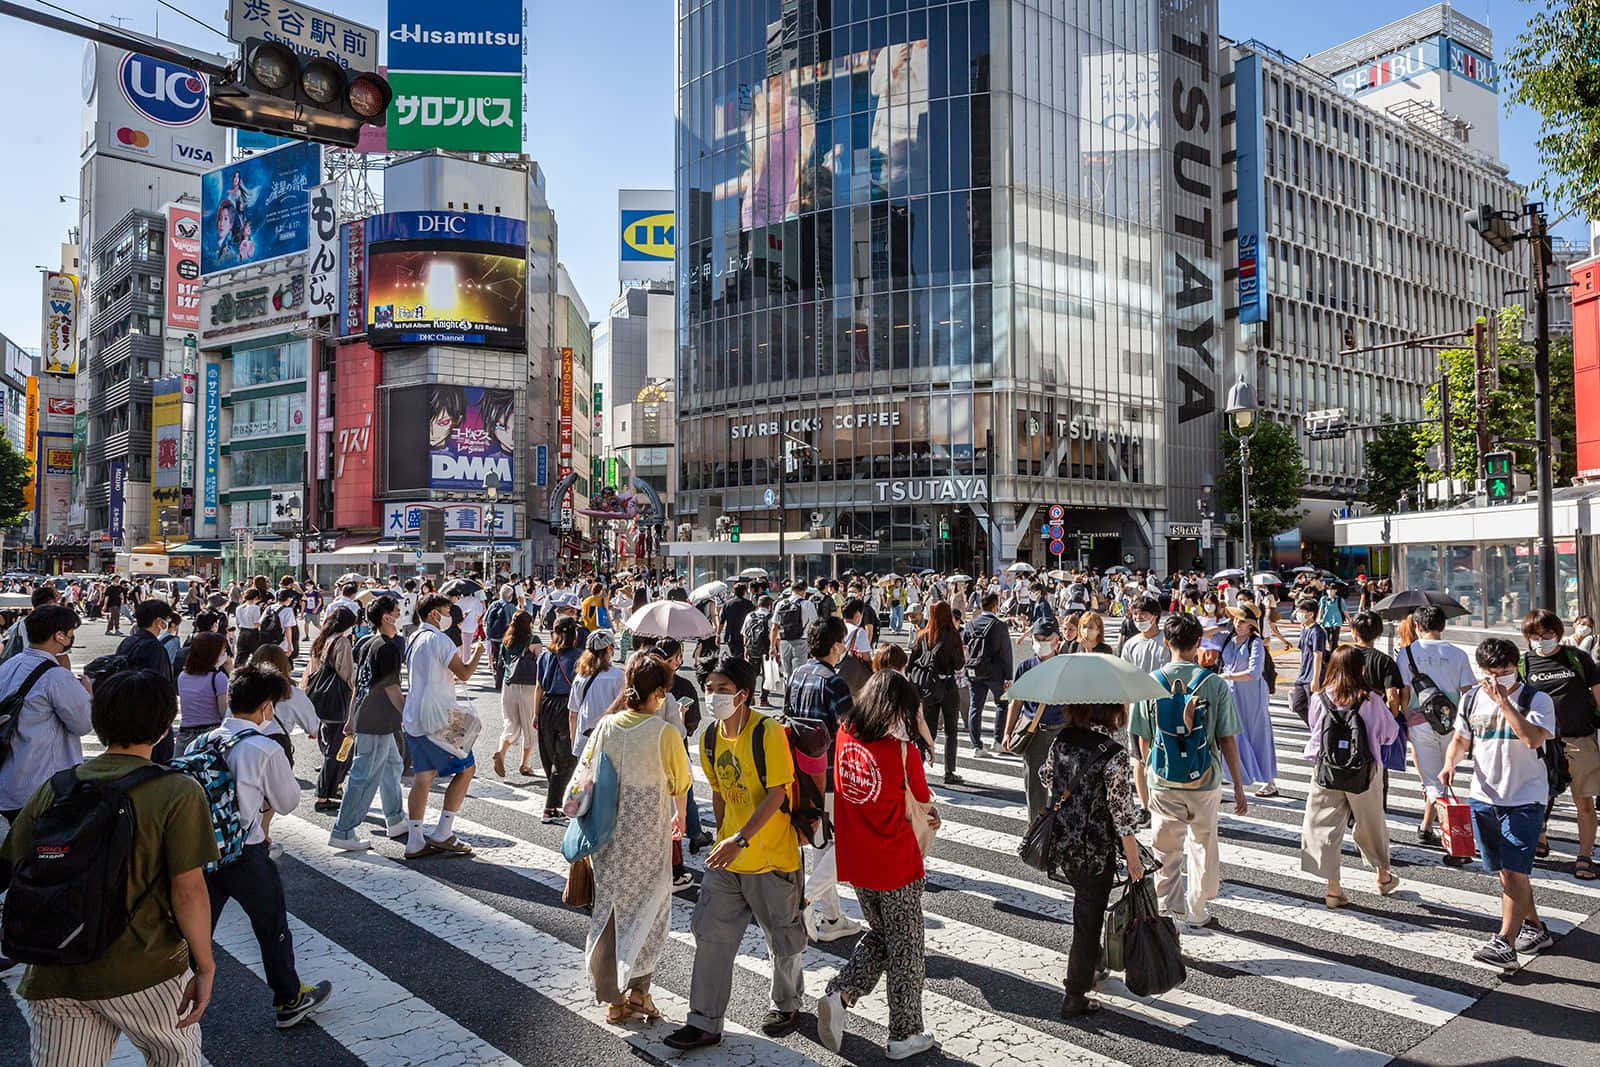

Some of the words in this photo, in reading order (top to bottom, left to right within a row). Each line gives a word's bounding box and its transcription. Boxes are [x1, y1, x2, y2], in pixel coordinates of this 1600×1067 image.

[243, 0, 368, 57] 渋谷駅前
[389, 23, 520, 45] Hisamitsu
[1342, 48, 1425, 92] SEIBU
[1450, 48, 1493, 86] SEIBU
[131, 60, 200, 109] UC
[395, 95, 513, 128] サロンパス
[176, 144, 214, 164] VISA
[418, 215, 466, 234] DHC
[1171, 31, 1215, 425] TSUTAYA
[311, 187, 336, 312] もんじゃ
[1239, 234, 1257, 311] SEIBU
[419, 333, 436, 342] DHC
[437, 333, 465, 342] Channel
[433, 319, 459, 331] Knight
[206, 380, 218, 465] サマーフルーツギフト
[833, 411, 901, 429] COFFEE
[1056, 418, 1140, 446] TSUTAYA
[337, 412, 372, 479] クスリ
[431, 454, 512, 481] DMM
[876, 478, 989, 501] TSUTAYA
[389, 507, 505, 530] 大盛書店
